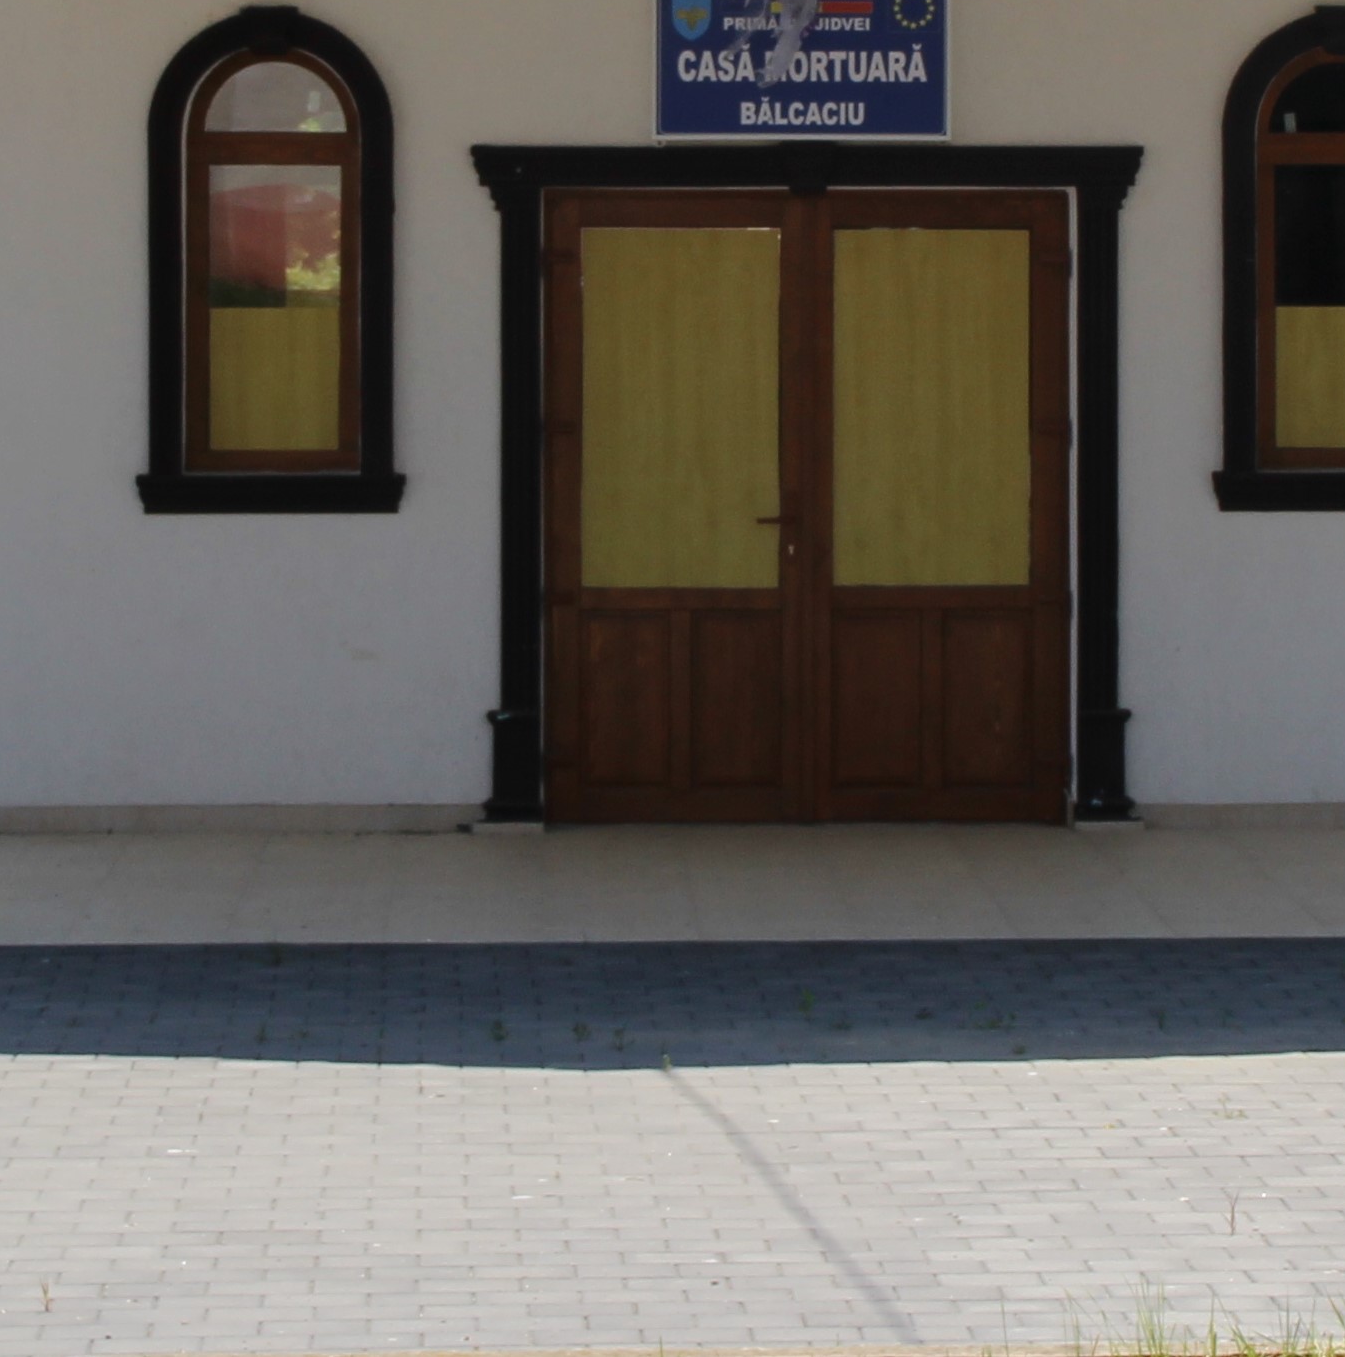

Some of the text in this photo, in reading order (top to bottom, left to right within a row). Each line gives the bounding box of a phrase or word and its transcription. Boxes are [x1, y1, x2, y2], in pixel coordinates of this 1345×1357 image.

[814, 16, 871, 31] JIDVEI
[677, 43, 756, 83] CASĂ
[740, 96, 865, 126] BĂLCACIU
